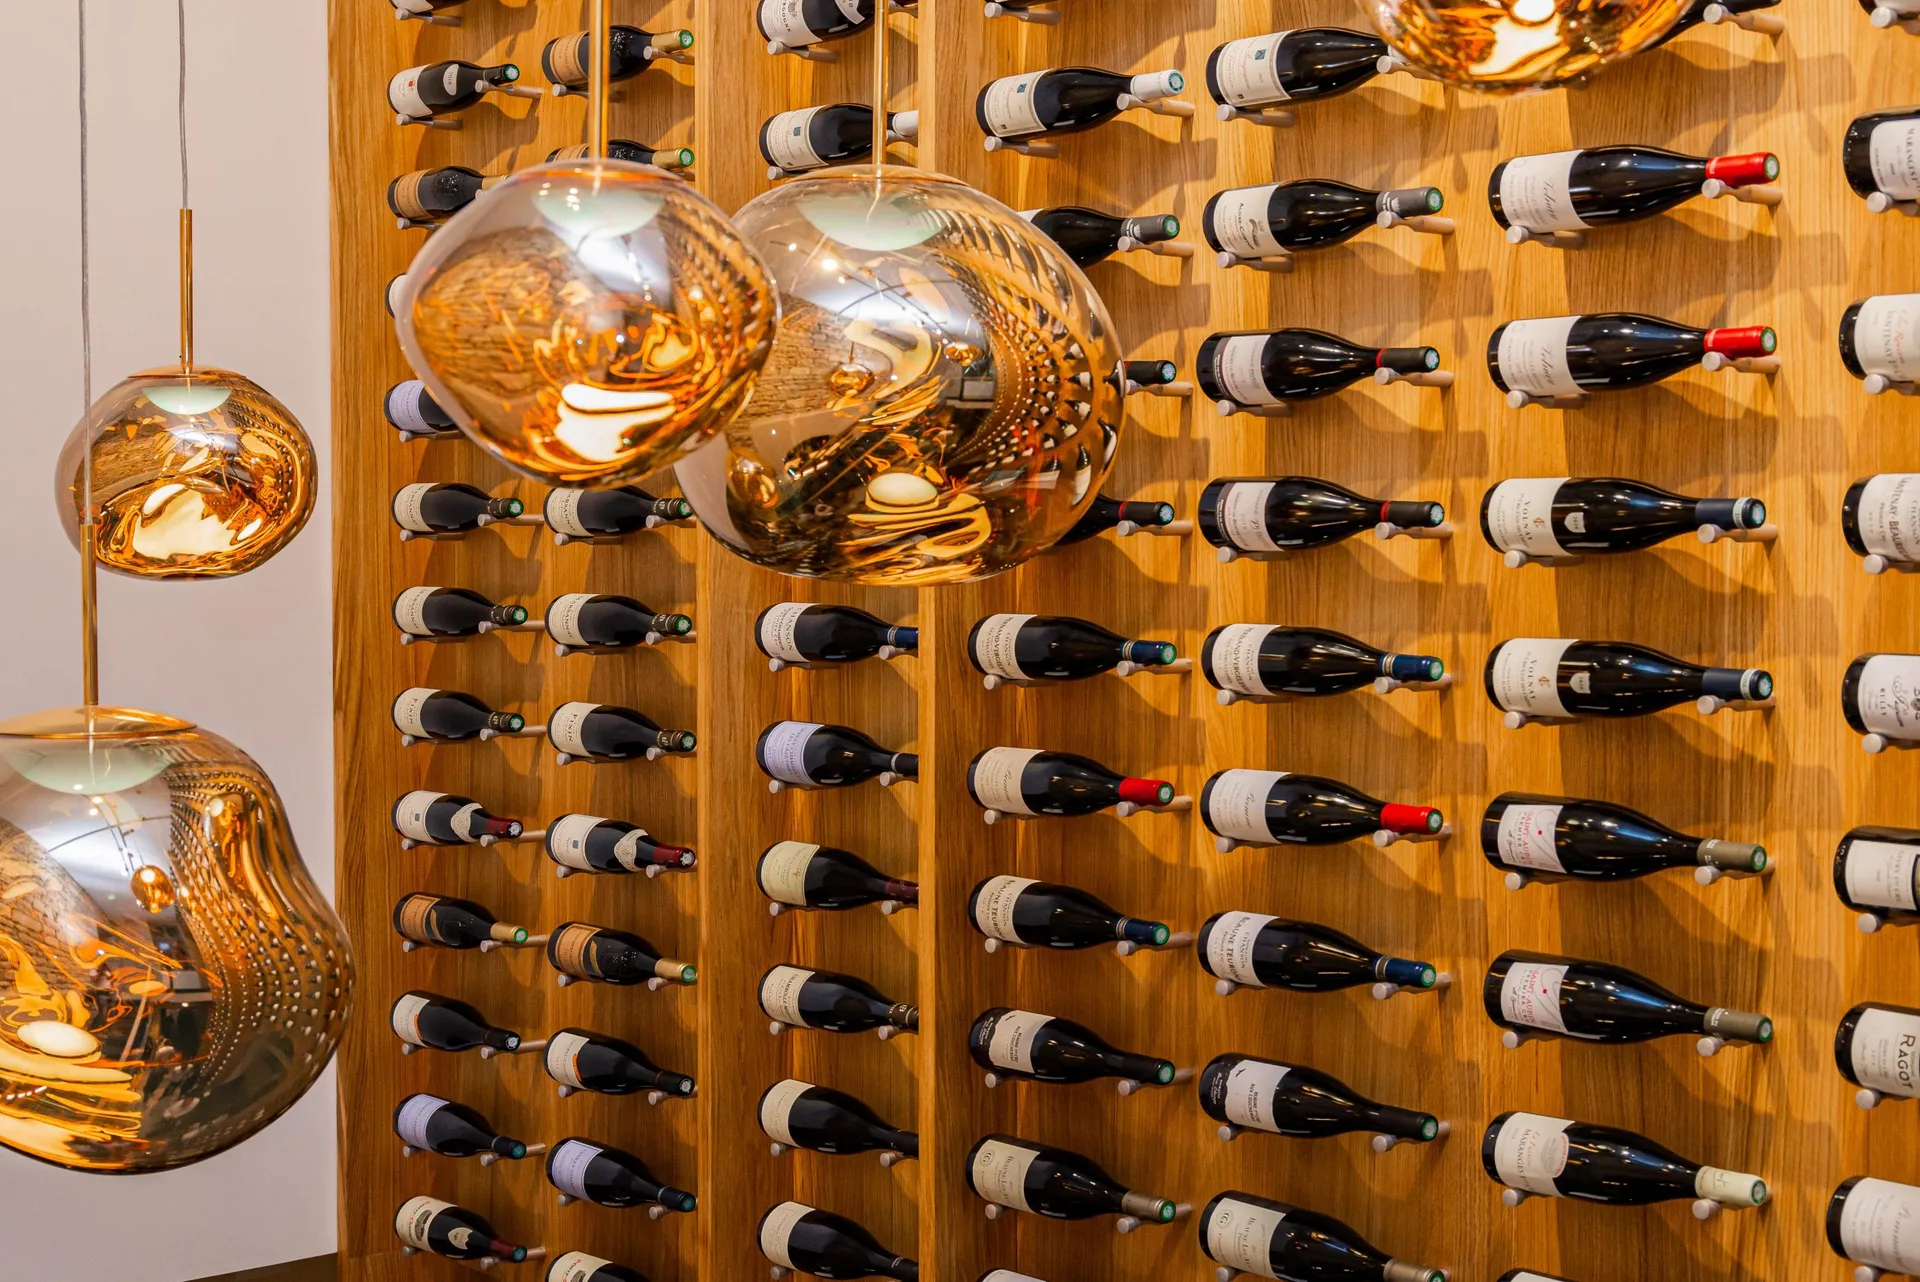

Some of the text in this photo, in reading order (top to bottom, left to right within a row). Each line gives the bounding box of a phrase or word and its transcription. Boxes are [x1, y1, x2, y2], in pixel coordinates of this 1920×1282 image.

[781, 0, 792, 33] RGOGNE
[1522, 500, 1534, 541] VOLNAY
[785, 607, 802, 652] CHANSON
[1003, 632, 1013, 667] CHANSON
[1244, 644, 1254, 682] CHANSON
[1527, 659, 1538, 701] VOLNAY
[408, 697, 419, 725] FIXIN
[1879, 688, 1888, 717] RULLY
[567, 713, 579, 743] FIXIN
[1002, 893, 1013, 927] CHANSON
[1239, 931, 1250, 969] CHANSON
[1520, 969, 1533, 1005] PREMIER
[1897, 1033, 1916, 1089] RAGOT
[1247, 1083, 1256, 1094] AUX
[1001, 1155, 1015, 1179] BEAUNE
[1516, 1128, 1532, 1174] MARANGES
[1242, 1216, 1257, 1241] BEAUNE
